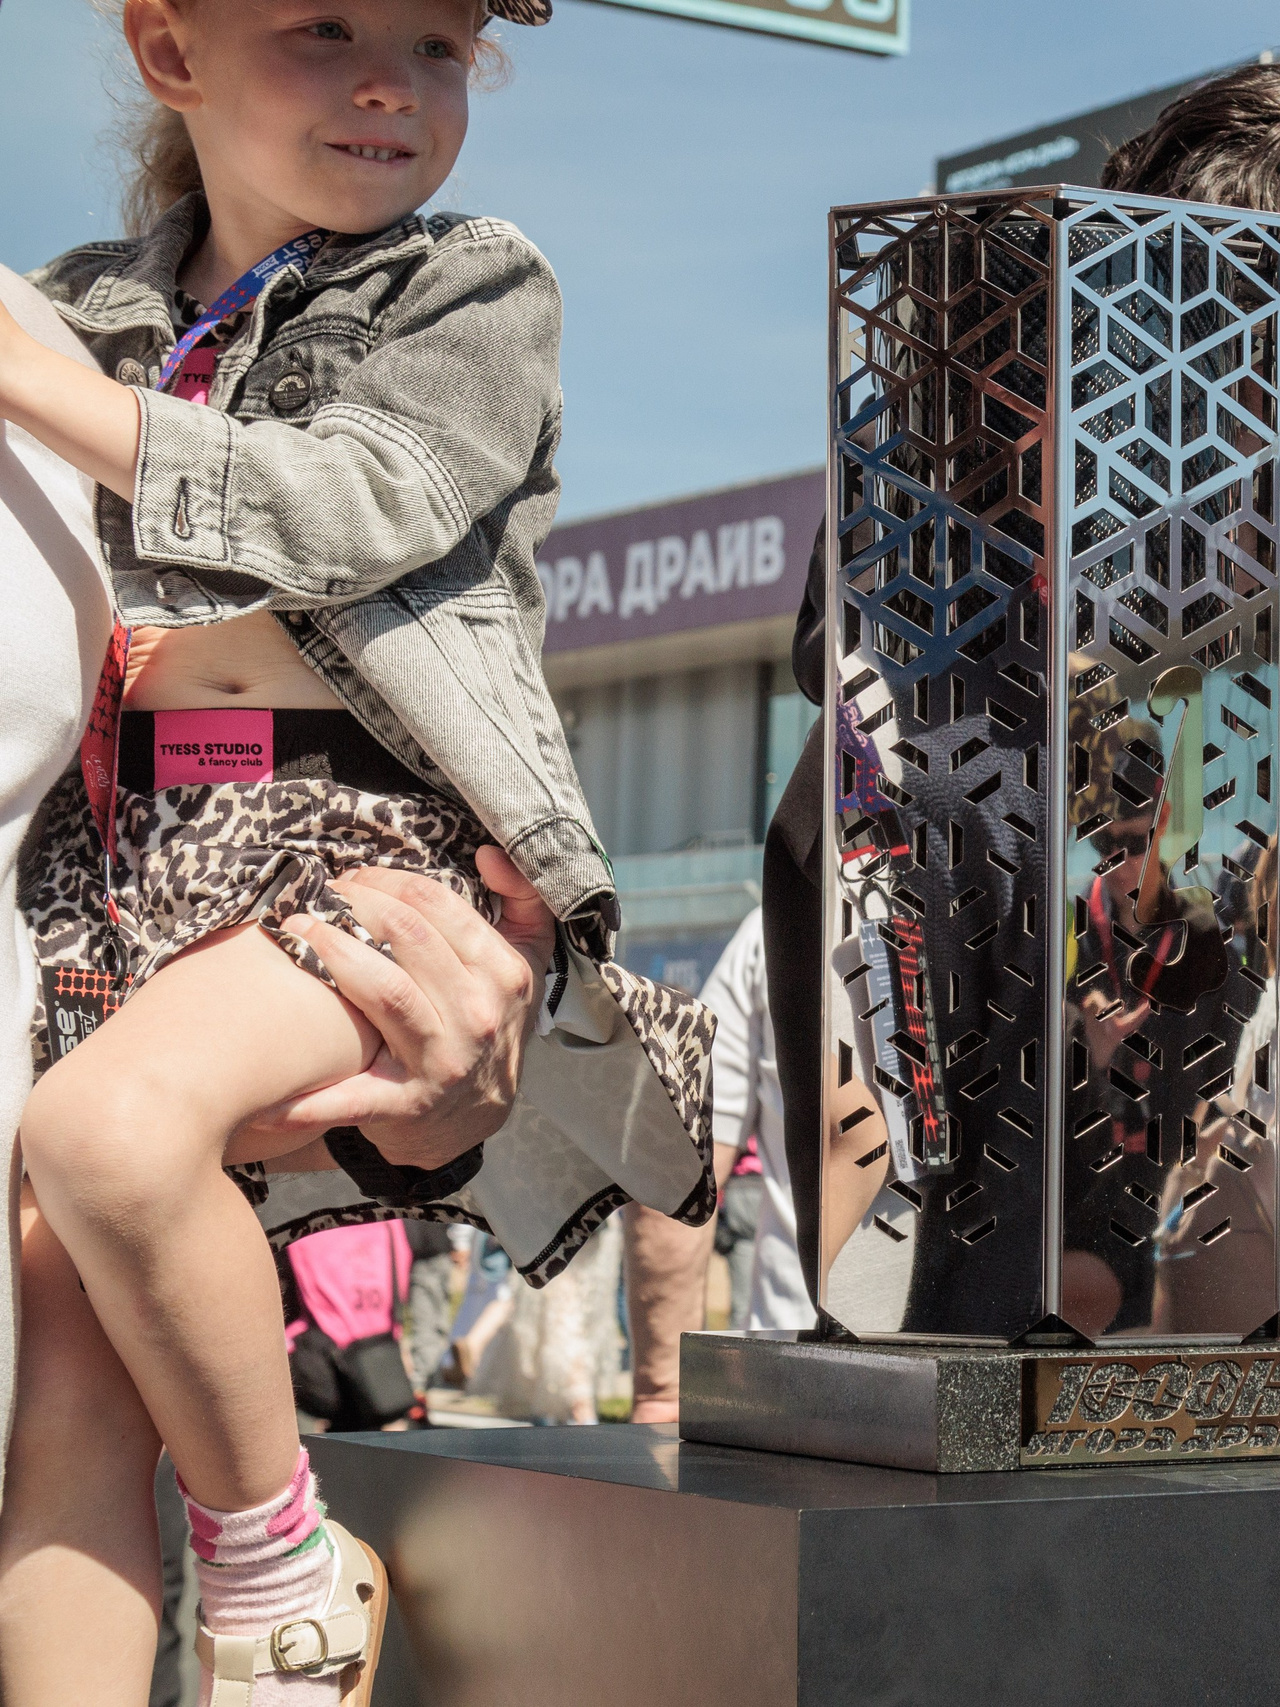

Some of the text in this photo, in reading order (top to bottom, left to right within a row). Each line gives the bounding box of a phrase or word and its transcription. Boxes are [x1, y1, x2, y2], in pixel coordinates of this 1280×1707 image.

[182, 373, 211, 384] TYE
[535, 550, 614, 622] ОРА
[160, 743, 263, 756] TYESS STUDIO
[198, 757, 263, 768] & fancy club
